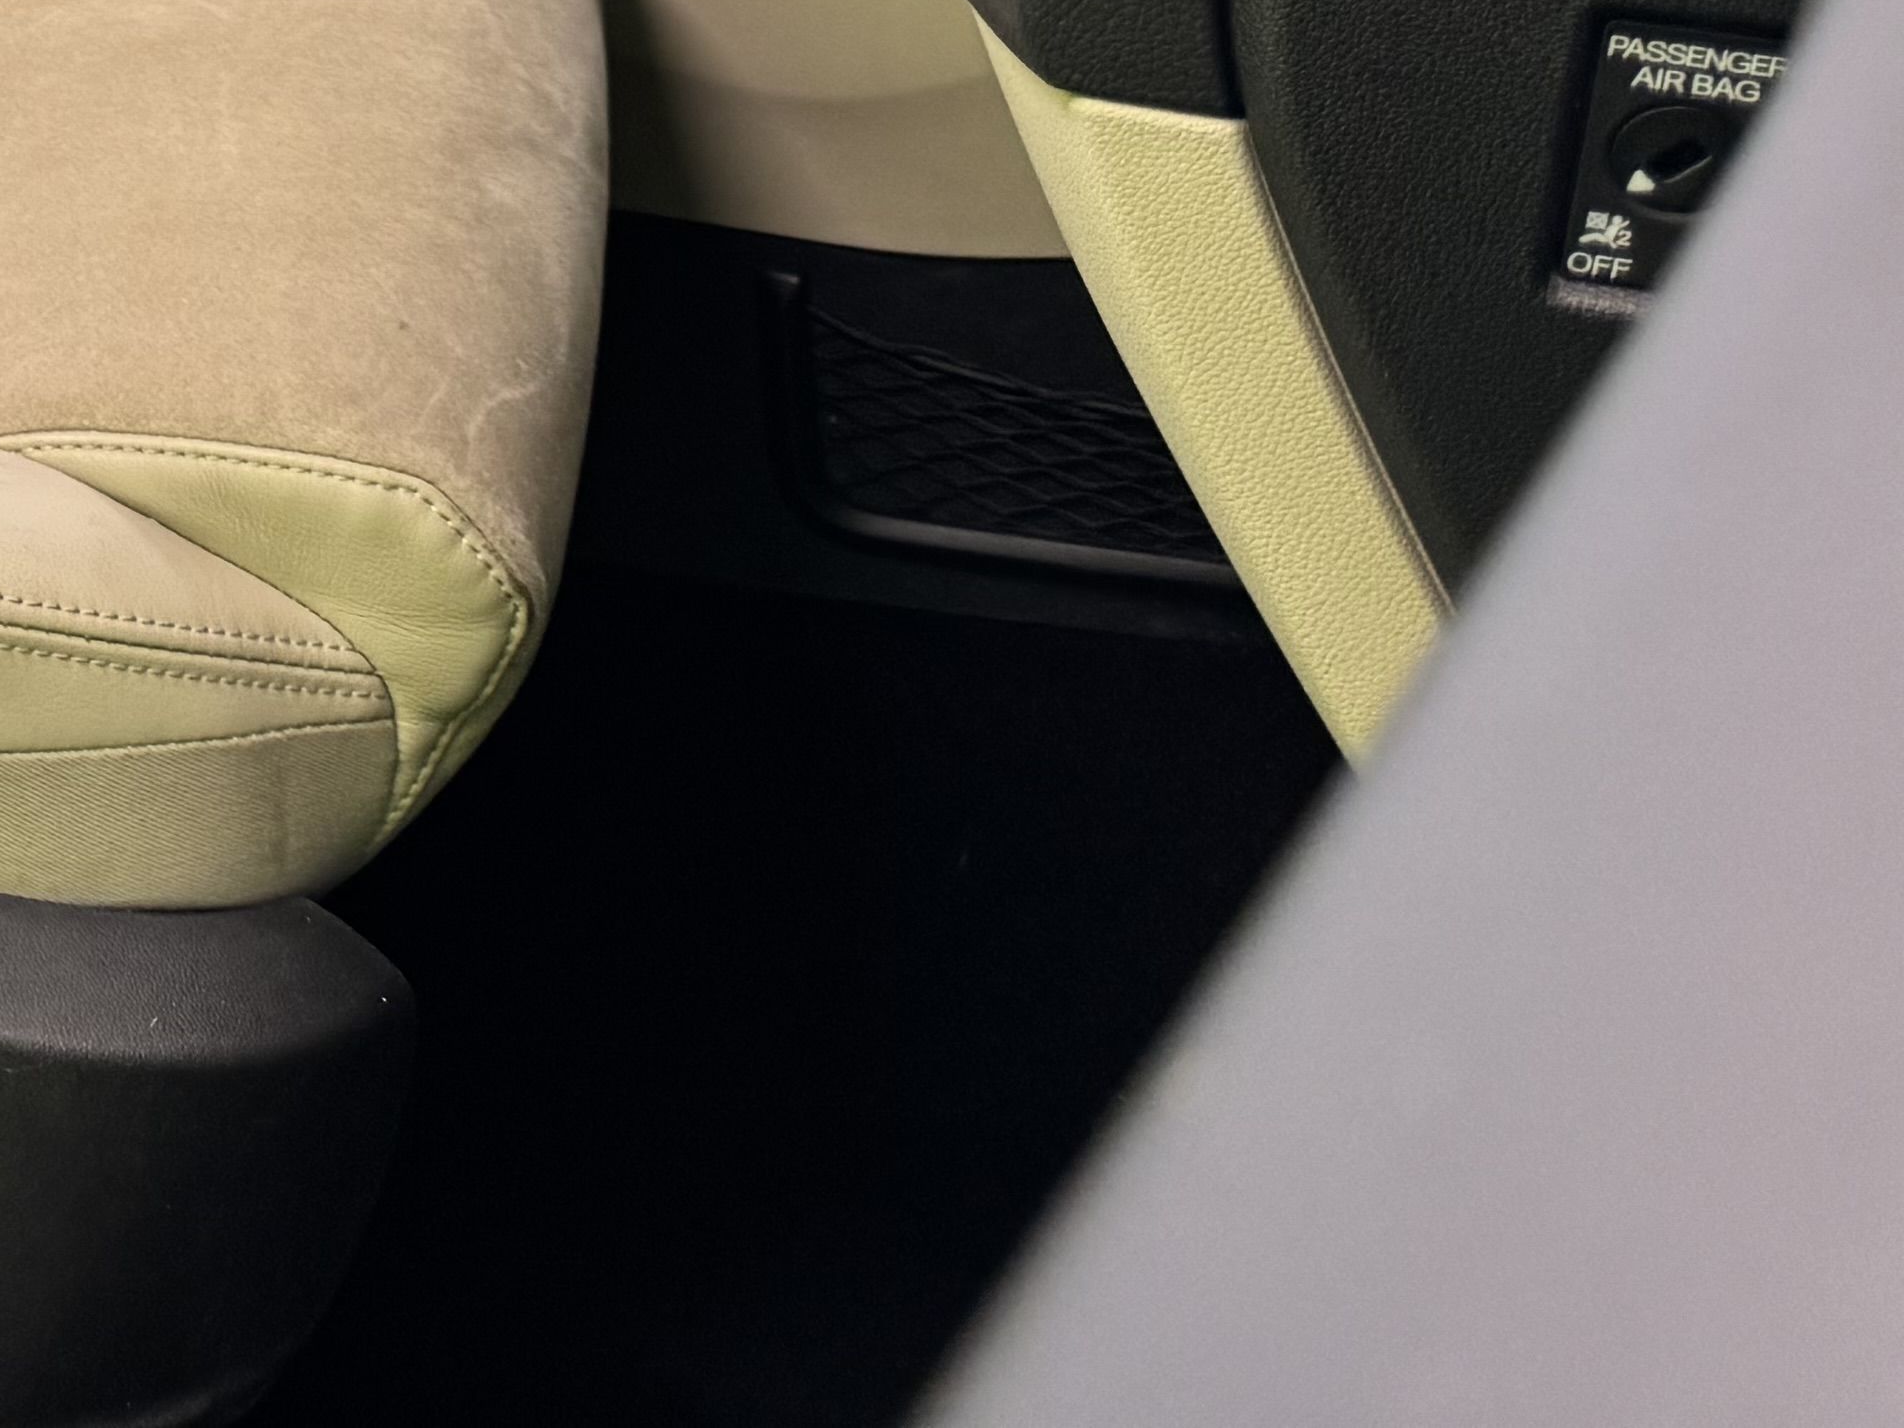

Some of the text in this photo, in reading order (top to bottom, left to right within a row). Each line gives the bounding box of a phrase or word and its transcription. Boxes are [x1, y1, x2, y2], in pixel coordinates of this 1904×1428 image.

[1630, 70, 1761, 103] AIR BAG
[1566, 251, 1633, 279] OFF
